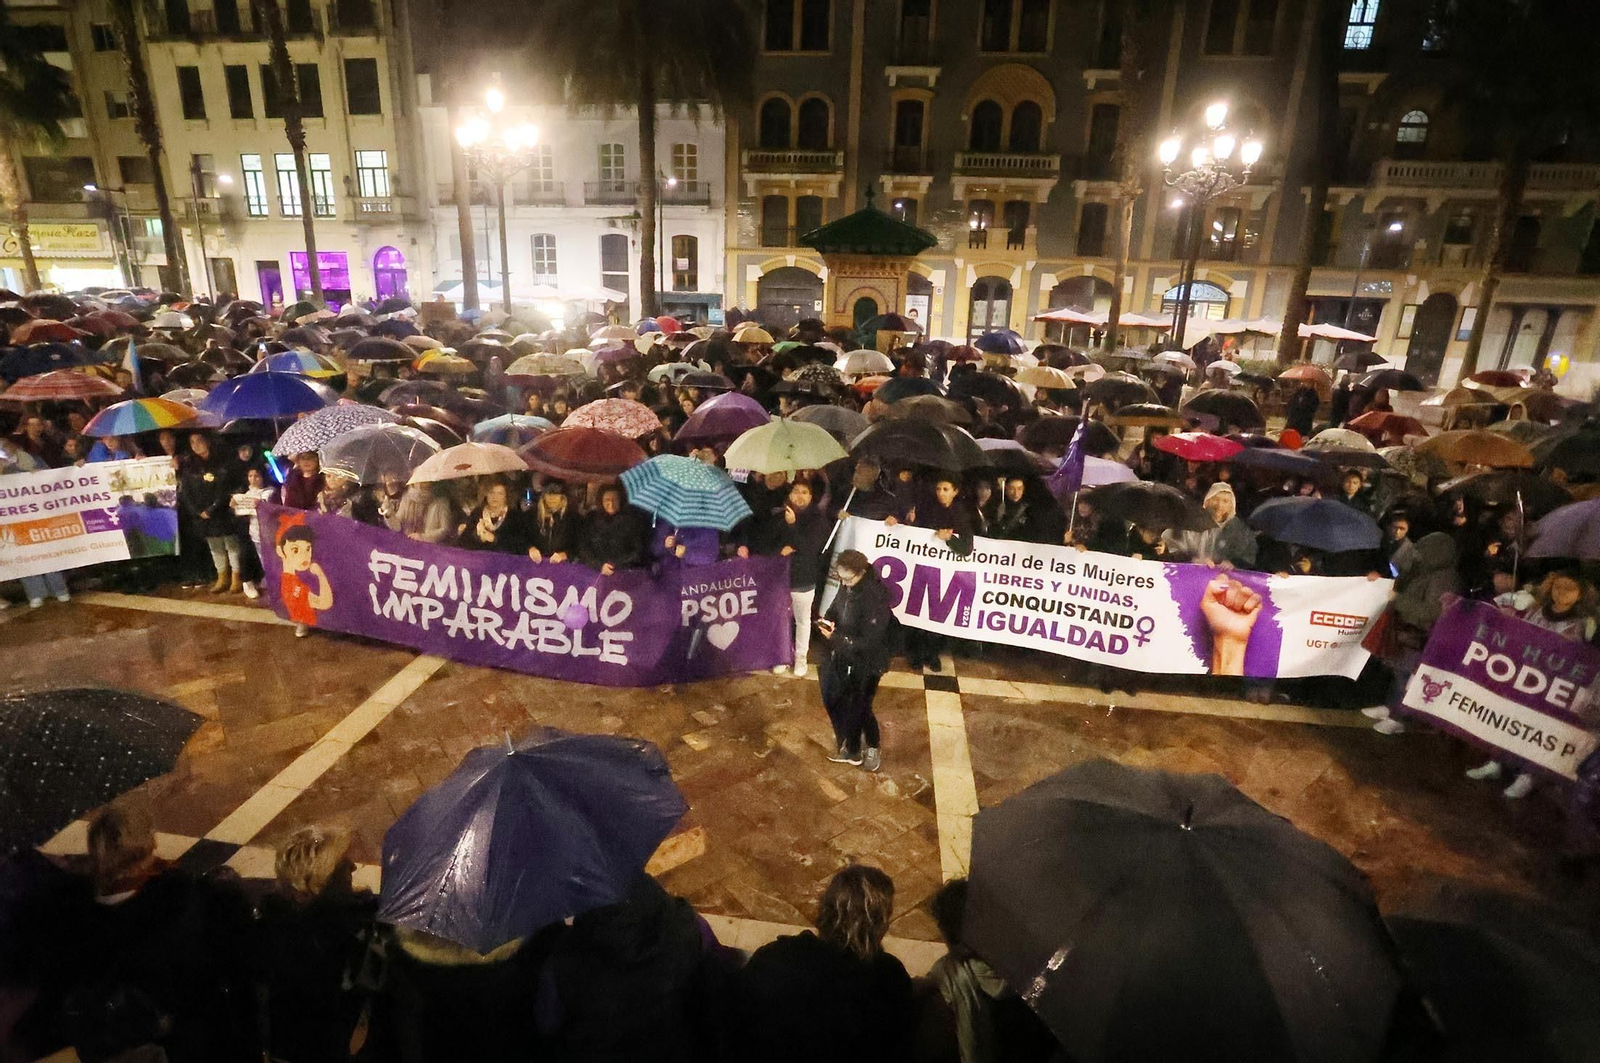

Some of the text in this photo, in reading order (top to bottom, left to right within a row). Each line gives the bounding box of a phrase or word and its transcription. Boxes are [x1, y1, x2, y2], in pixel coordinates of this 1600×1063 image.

[78, 476, 100, 488] DE
[43, 492, 111, 511] GITANAS
[29, 524, 81, 542] Gitano
[875, 533, 1155, 588] Día Internacional de las Mujeres
[368, 549, 633, 627] FEMINISMO
[681, 574, 757, 596] ANDALUCÍA
[872, 555, 977, 628] 8M
[983, 572, 1139, 611] LIBRES Y UNIDAS,
[369, 583, 634, 666] IMPARABLE
[681, 590, 758, 627] PSOE
[961, 605, 971, 627] 2024
[976, 610, 1129, 655] IGUALDAD
[1306, 639, 1330, 649] UGT
[1448, 691, 1558, 752] FEMINISTAS
